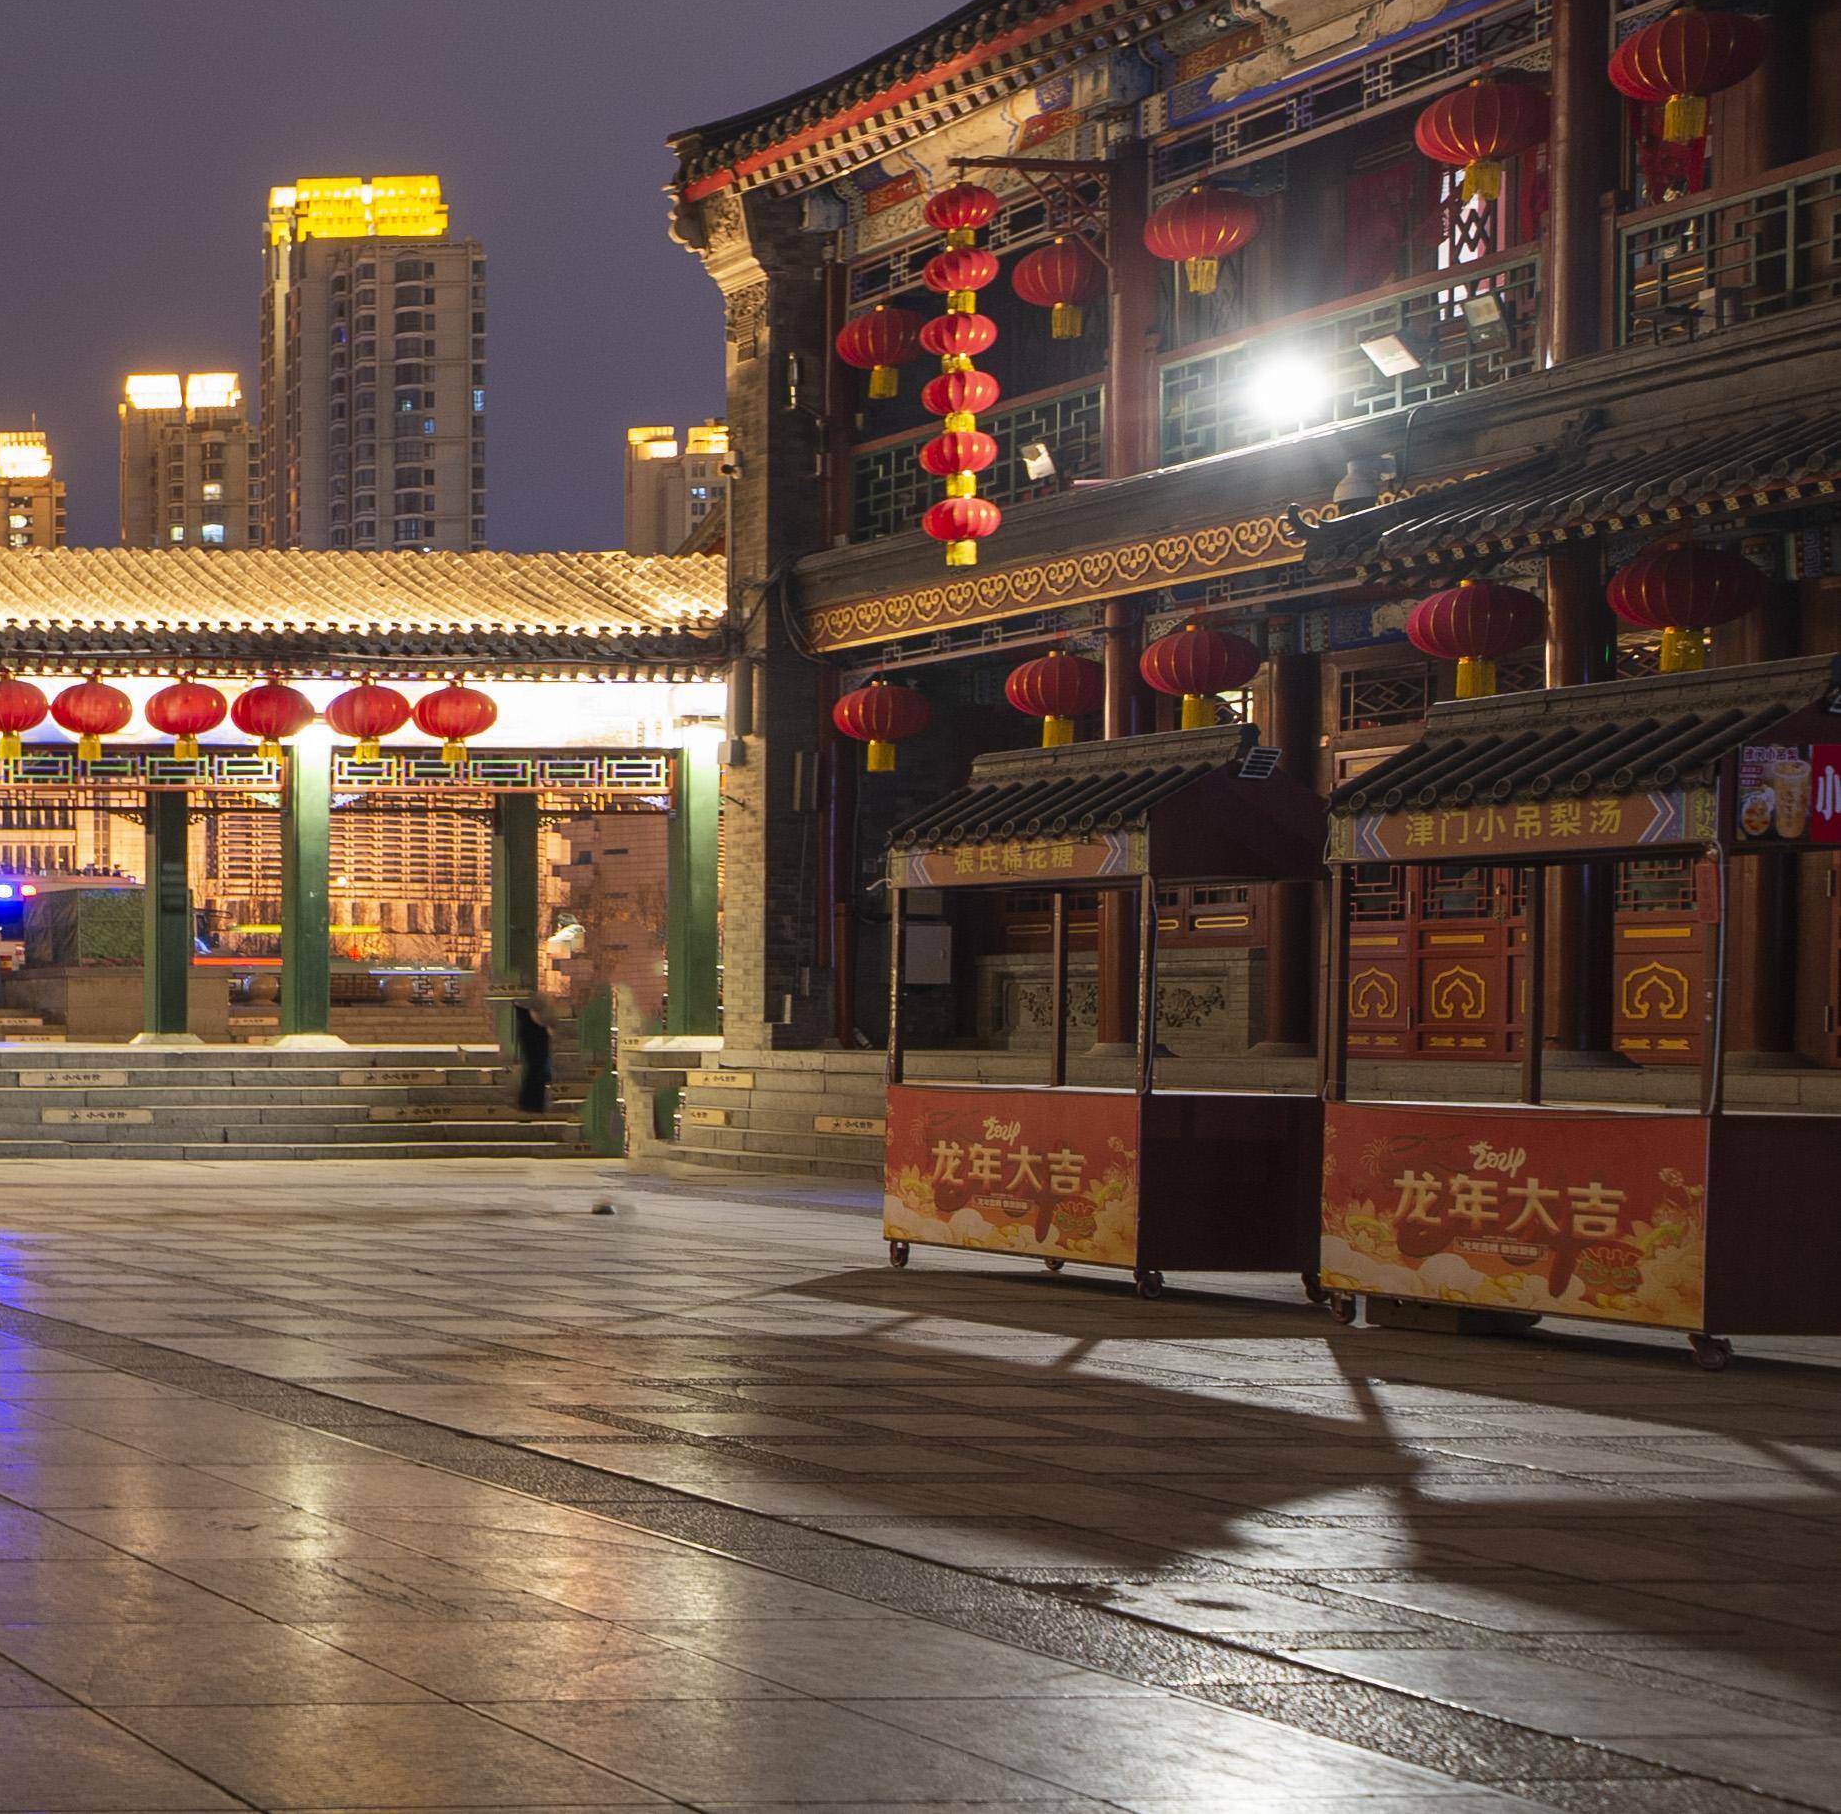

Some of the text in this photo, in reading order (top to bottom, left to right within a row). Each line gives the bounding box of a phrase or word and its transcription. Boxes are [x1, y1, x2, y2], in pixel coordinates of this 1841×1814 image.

[1405, 798, 1623, 847] 津门小吊梨汤
[931, 1140, 1086, 1194] 龙年大吉
[1393, 1170, 1627, 1237] 龙年大吉
